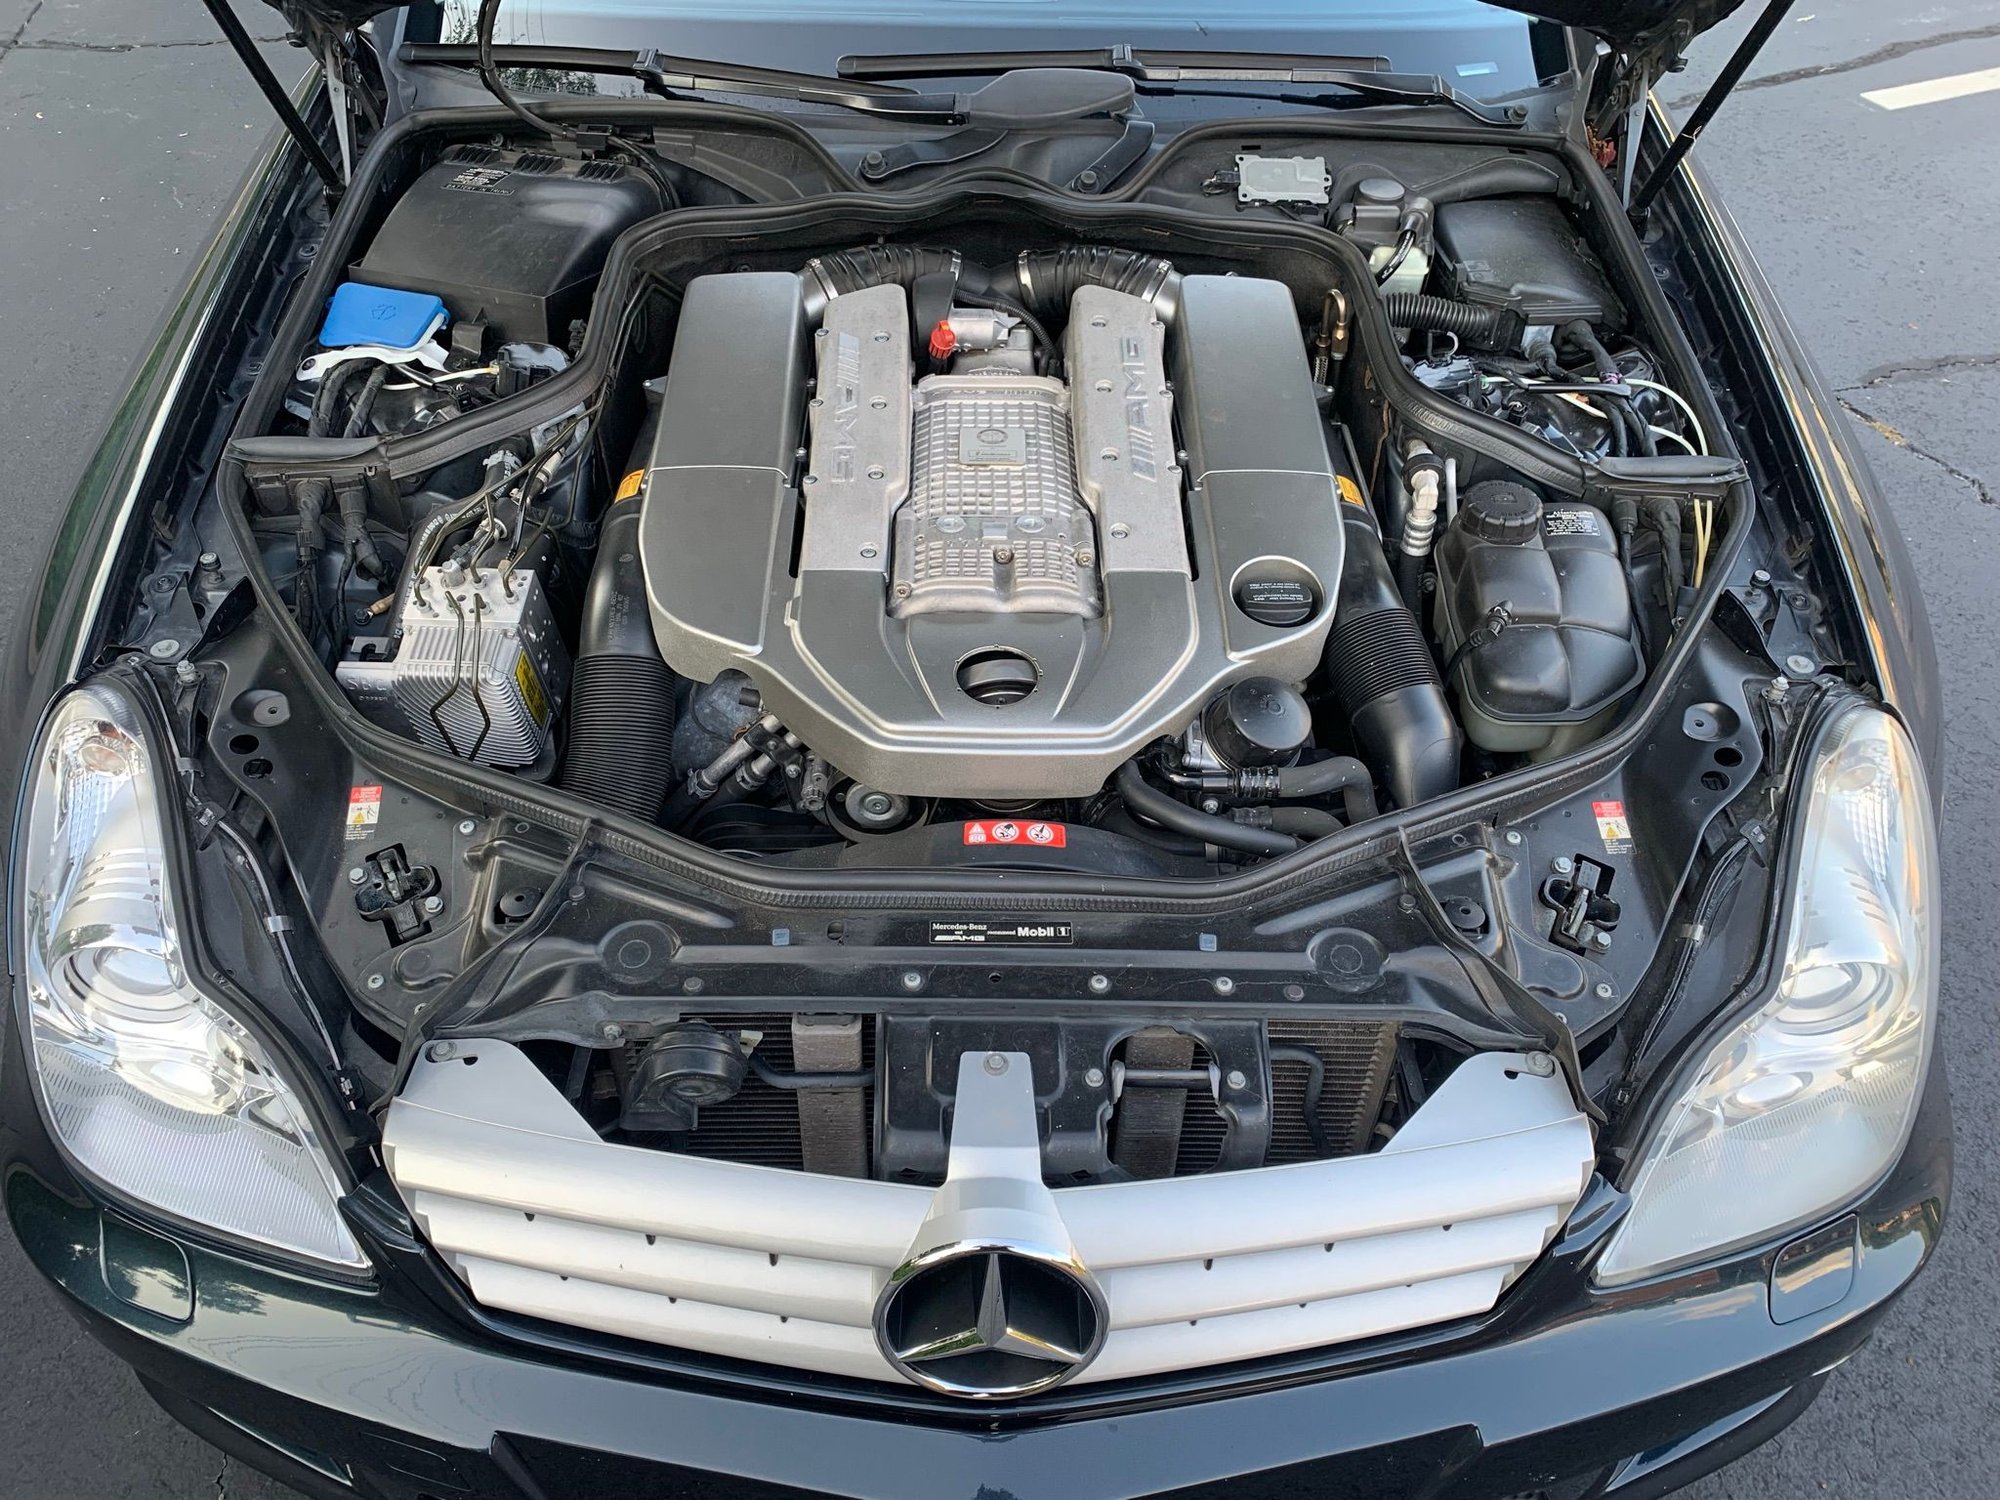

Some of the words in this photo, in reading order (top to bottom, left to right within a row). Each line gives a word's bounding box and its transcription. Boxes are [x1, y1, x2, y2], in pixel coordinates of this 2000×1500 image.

[1120, 336, 1150, 429] AMG
[831, 384, 858, 483] AMG
[932, 922, 987, 931] Mercedes-Benz
[1017, 926, 1054, 937] Mobil
